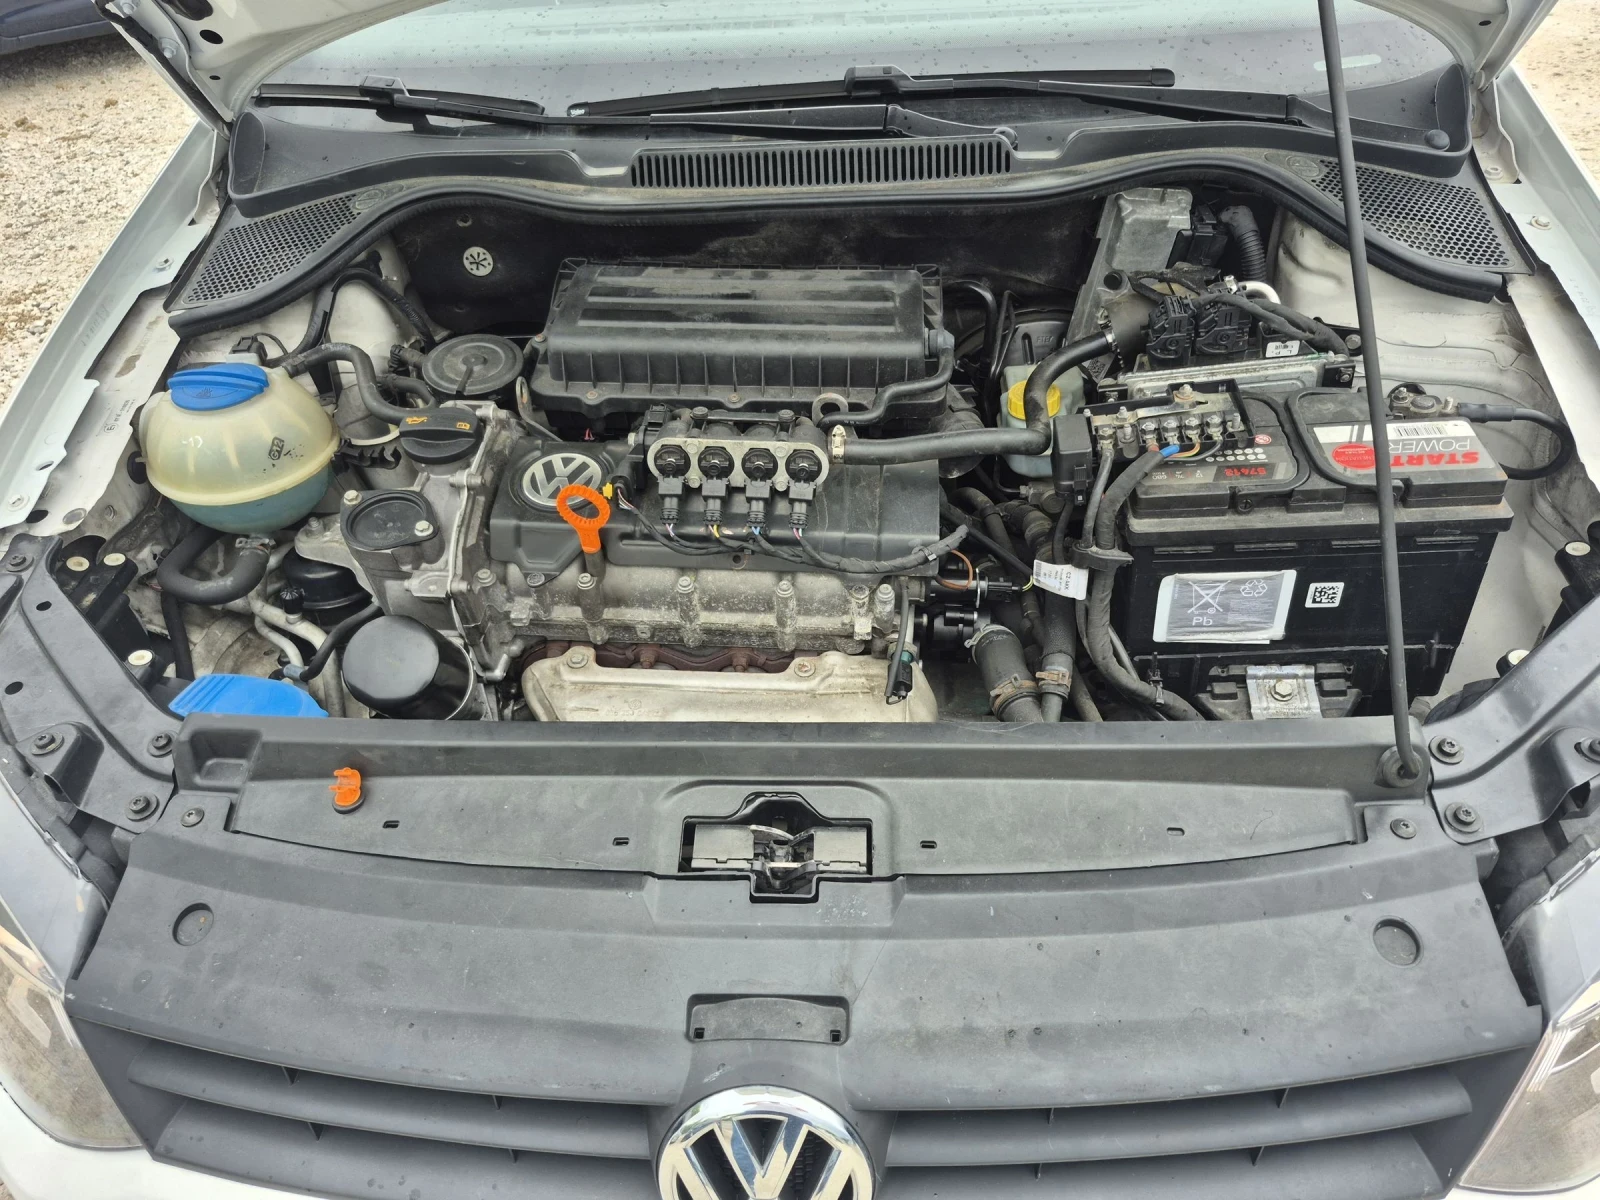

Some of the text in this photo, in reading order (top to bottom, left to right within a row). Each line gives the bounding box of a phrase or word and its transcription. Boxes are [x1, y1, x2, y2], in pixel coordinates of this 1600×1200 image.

[270, 439, 283, 460] G12
[1389, 438, 1470, 453] POWER
[1390, 451, 1479, 467] START
[1192, 616, 1213, 626] Pb
